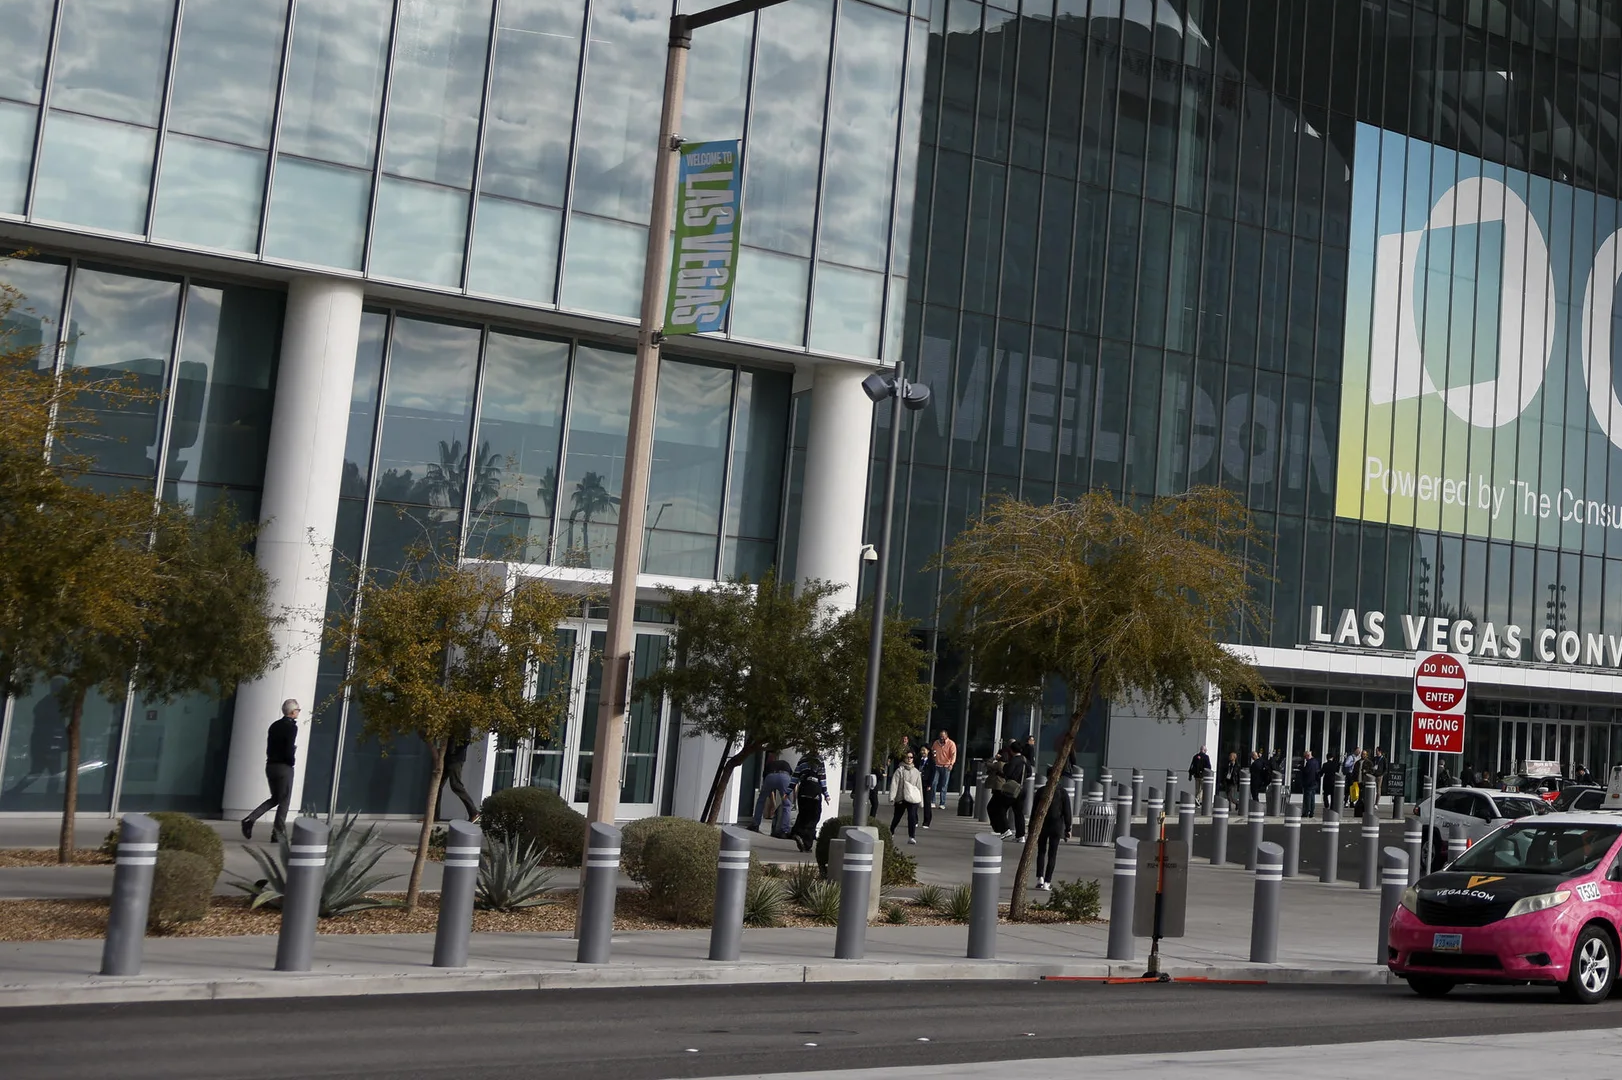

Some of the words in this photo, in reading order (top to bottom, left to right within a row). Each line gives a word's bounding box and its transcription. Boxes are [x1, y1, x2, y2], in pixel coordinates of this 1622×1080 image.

[686, 152, 721, 166] WELCOME
[721, 151, 733, 165] TO
[683, 171, 735, 227] LAS
[671, 232, 734, 325] VEGAS
[1364, 456, 1471, 506] Powered
[1478, 474, 1505, 520] by
[1509, 479, 1550, 518] The
[1310, 605, 1385, 647] LAS
[1400, 614, 1522, 659] VEGAS
[1423, 663, 1436, 673] DO
[1441, 664, 1460, 674] NOT
[1425, 692, 1455, 703] ENTER
[1418, 718, 1459, 731] WRONG
[1425, 733, 1450, 746] WAY
[1436, 888, 1496, 902] VEGAS.COM
[1576, 883, 1600, 901] 7532
